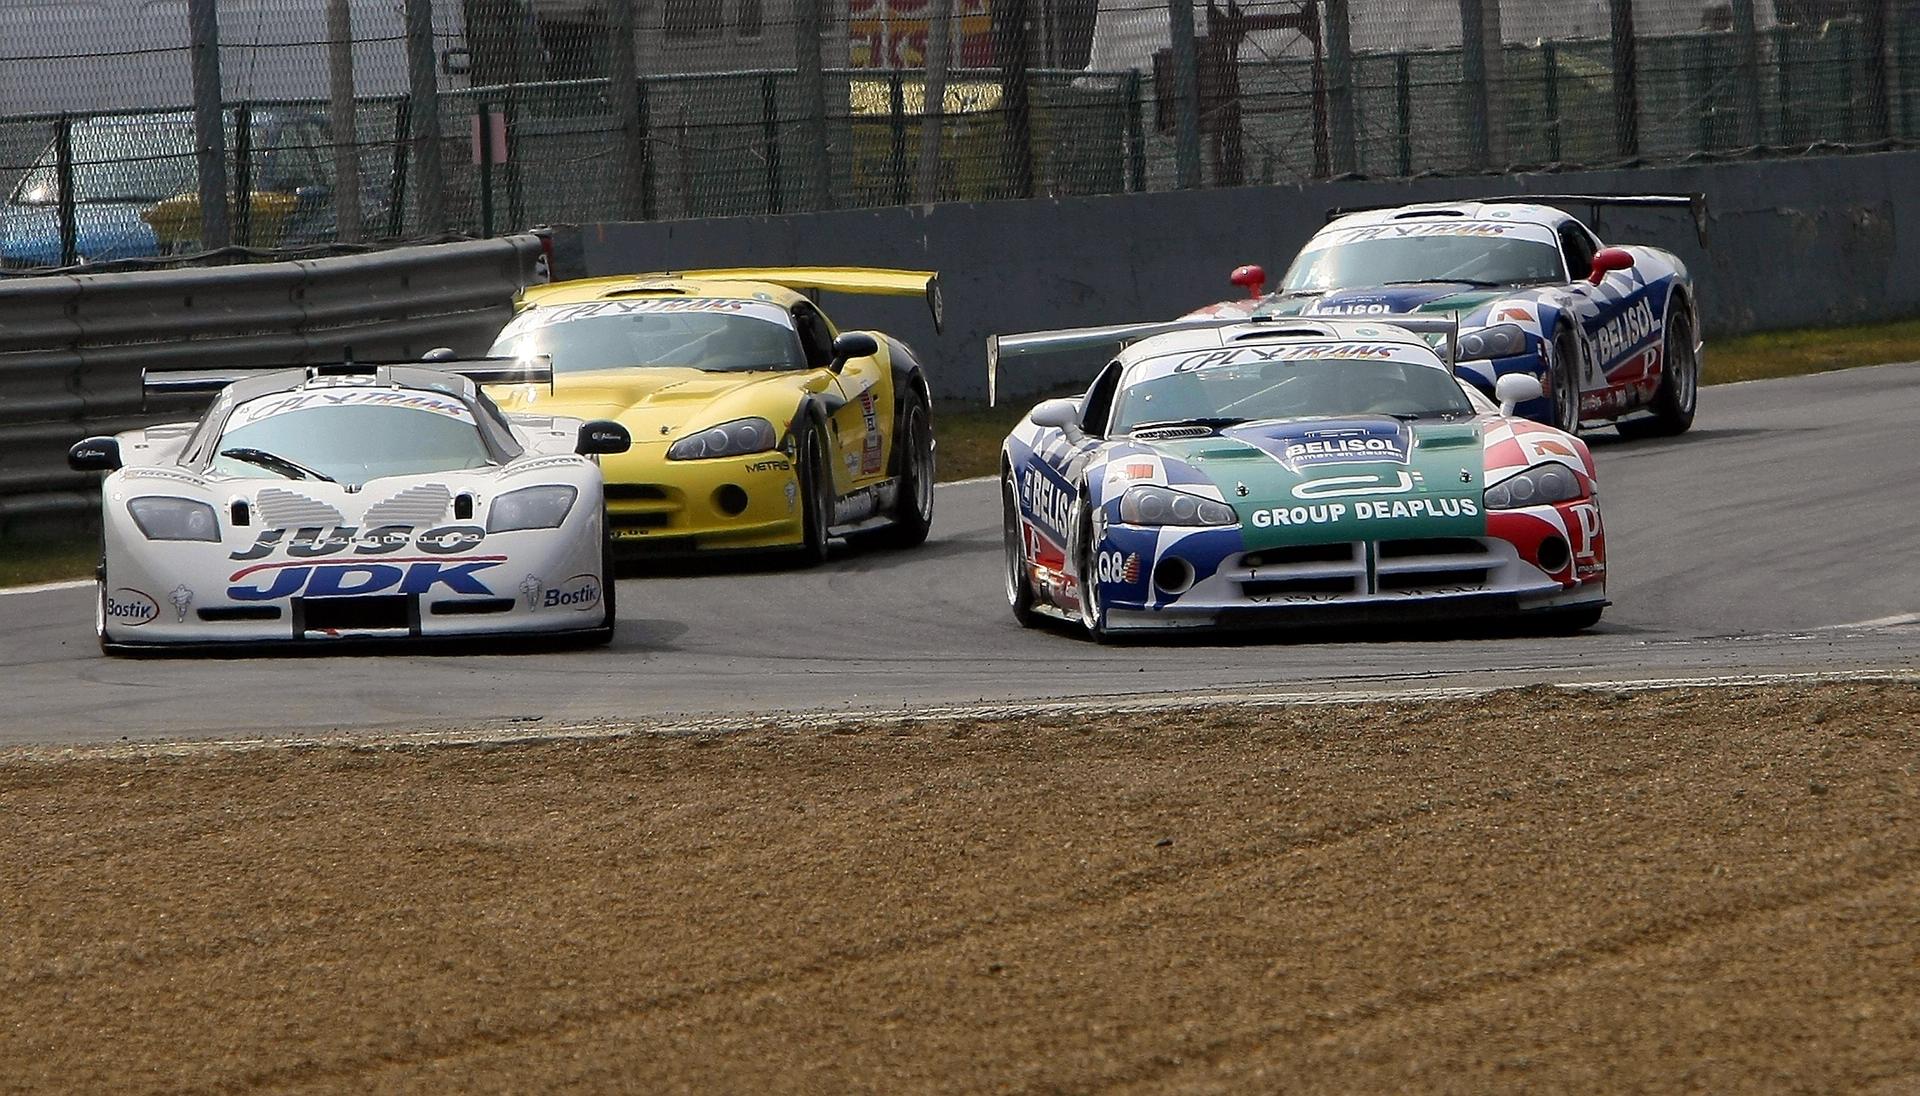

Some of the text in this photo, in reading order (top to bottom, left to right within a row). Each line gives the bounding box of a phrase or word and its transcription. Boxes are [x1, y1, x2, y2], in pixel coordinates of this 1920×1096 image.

[1420, 223, 1515, 236] TRANS
[642, 297, 754, 311] TRANS
[1597, 296, 1662, 365] BELISOL
[1174, 344, 1401, 373] CPL TRANS
[361, 392, 470, 415] TRANS
[1286, 438, 1402, 456] BELISOL
[1251, 498, 1478, 528] GROUP DEAPLUS
[228, 524, 486, 561] JUSO
[1569, 503, 1601, 558] P
[1098, 550, 1123, 583] Q8
[227, 562, 505, 601] JDK
[544, 585, 598, 608] Bostik
